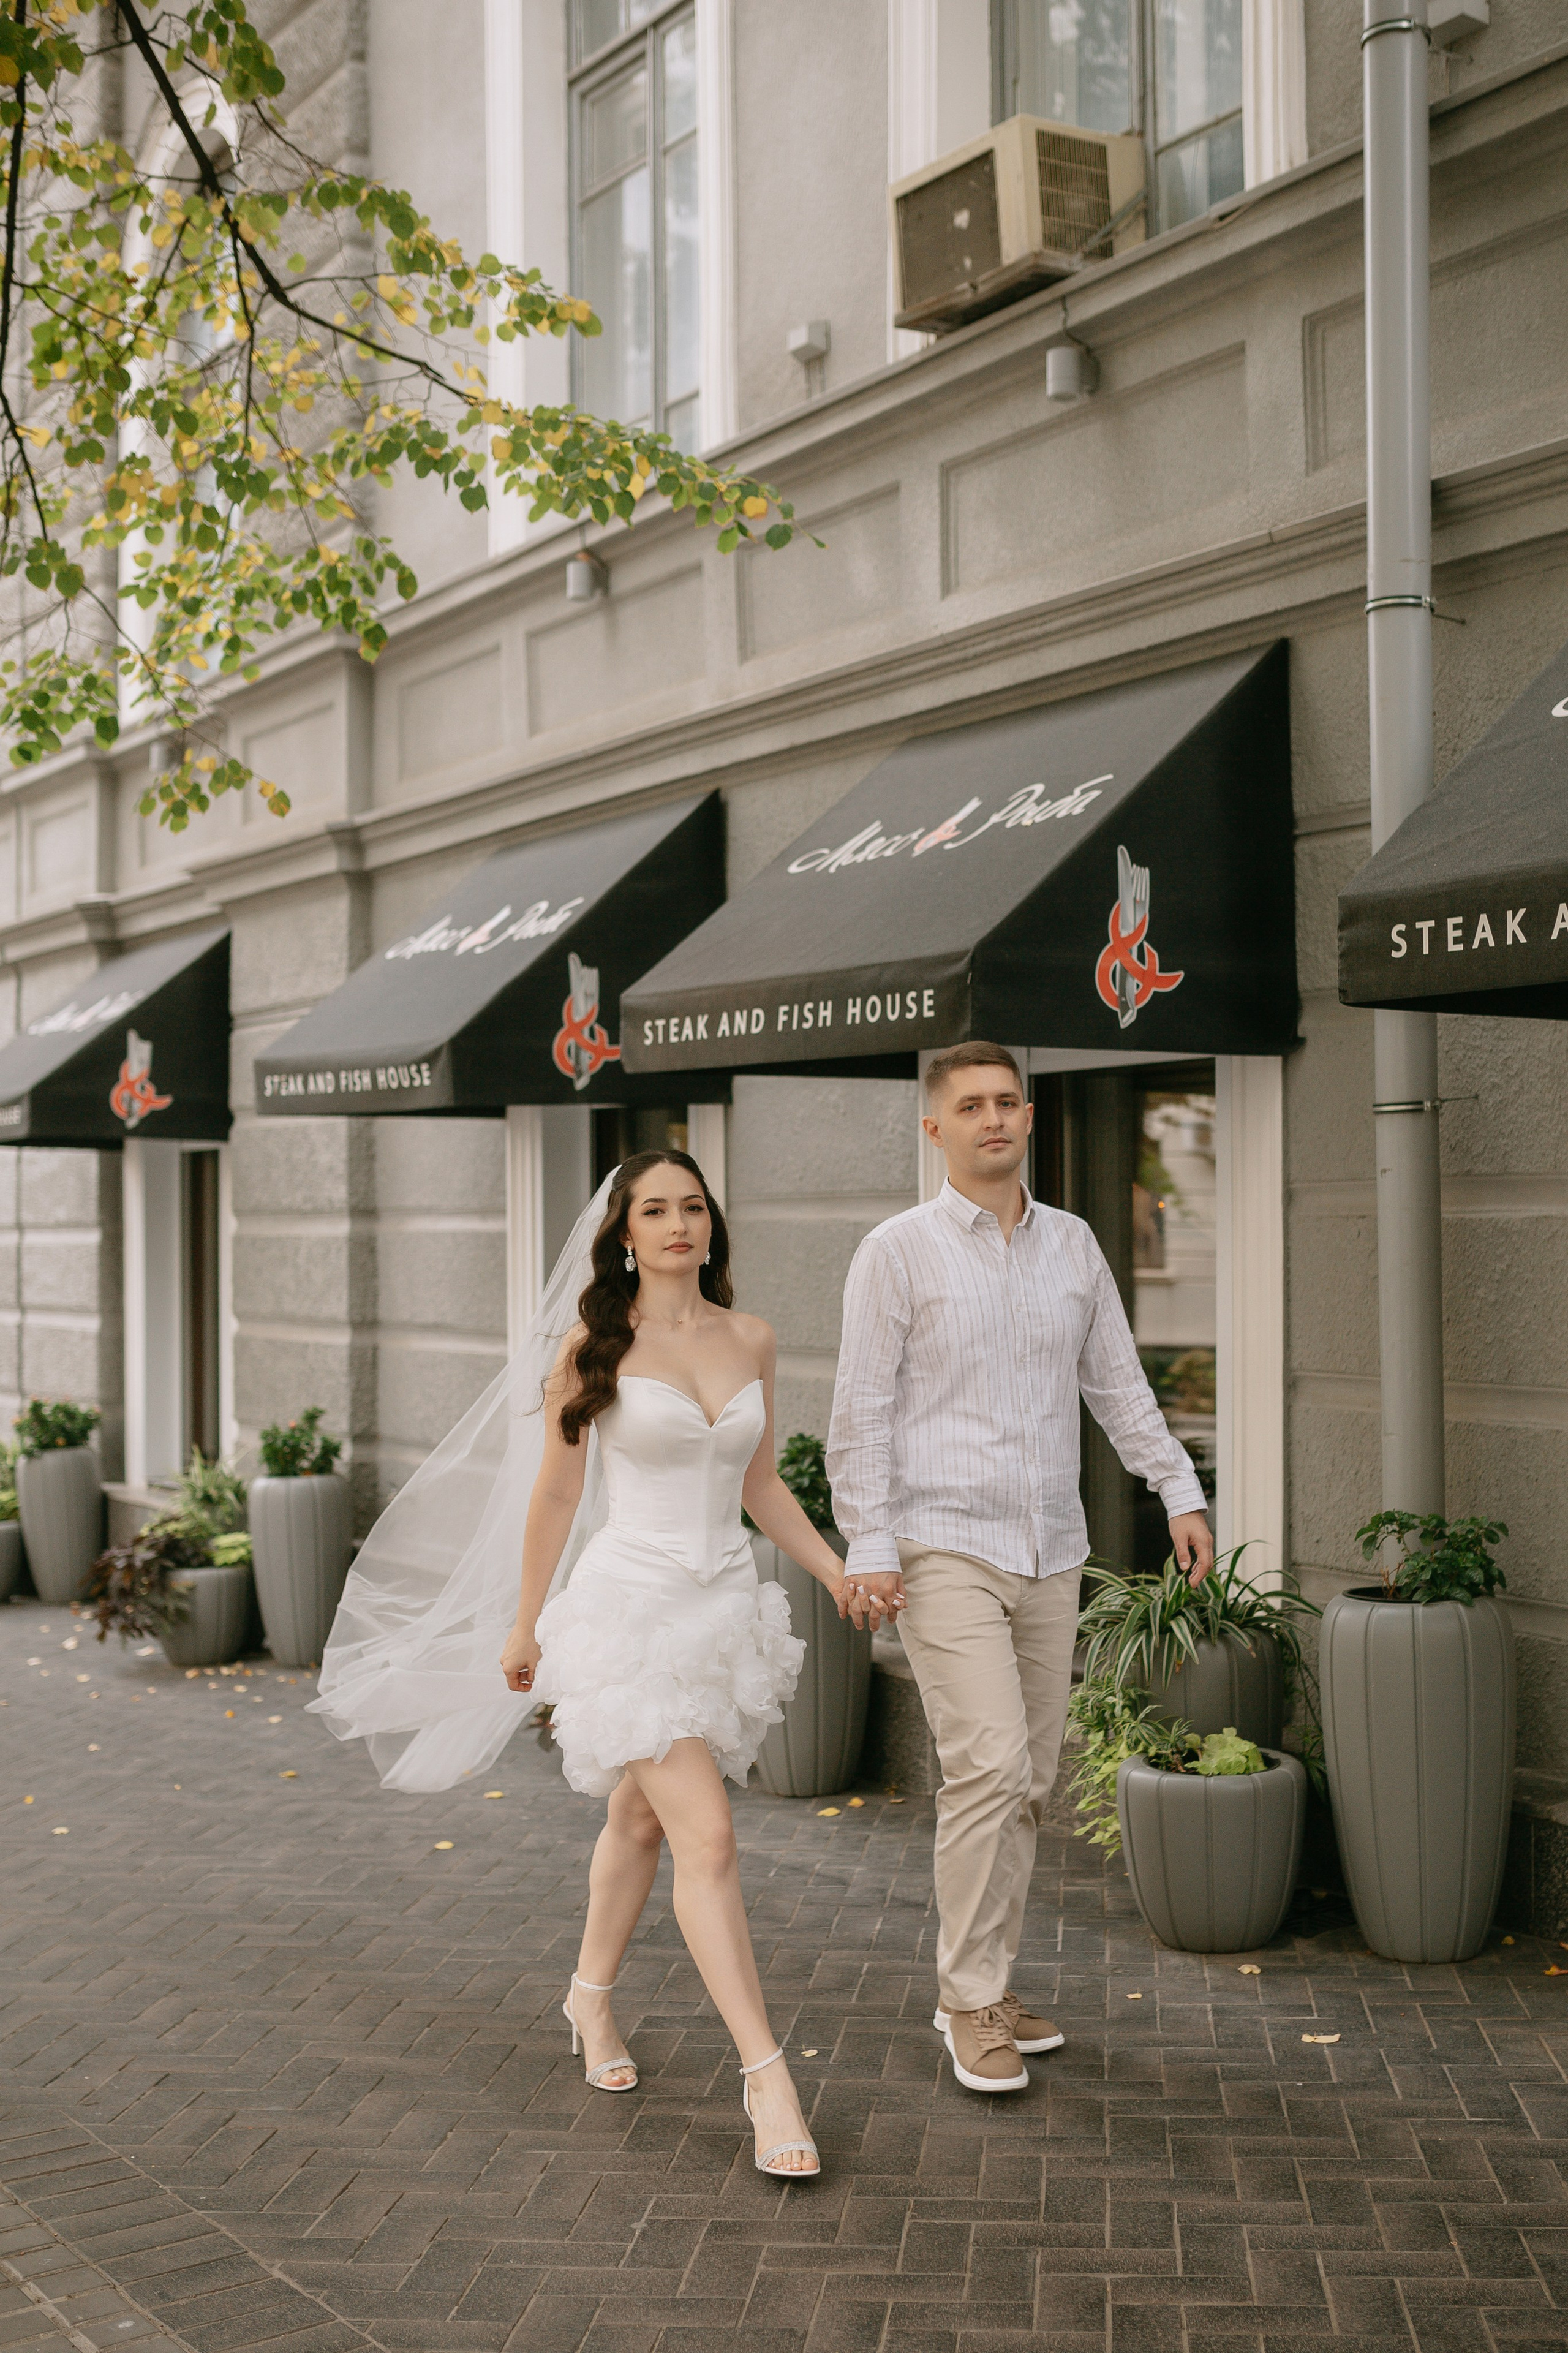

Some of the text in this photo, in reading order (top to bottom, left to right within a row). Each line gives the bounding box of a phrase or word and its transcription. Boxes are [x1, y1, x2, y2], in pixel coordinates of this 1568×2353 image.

[1390, 908, 1528, 959] STEAK
[643, 989, 935, 1046] STEAK AND FISH HOUSE
[307, 1071, 336, 1095] AND
[339, 1068, 372, 1093] FISH
[375, 1062, 431, 1090] HOUSE
